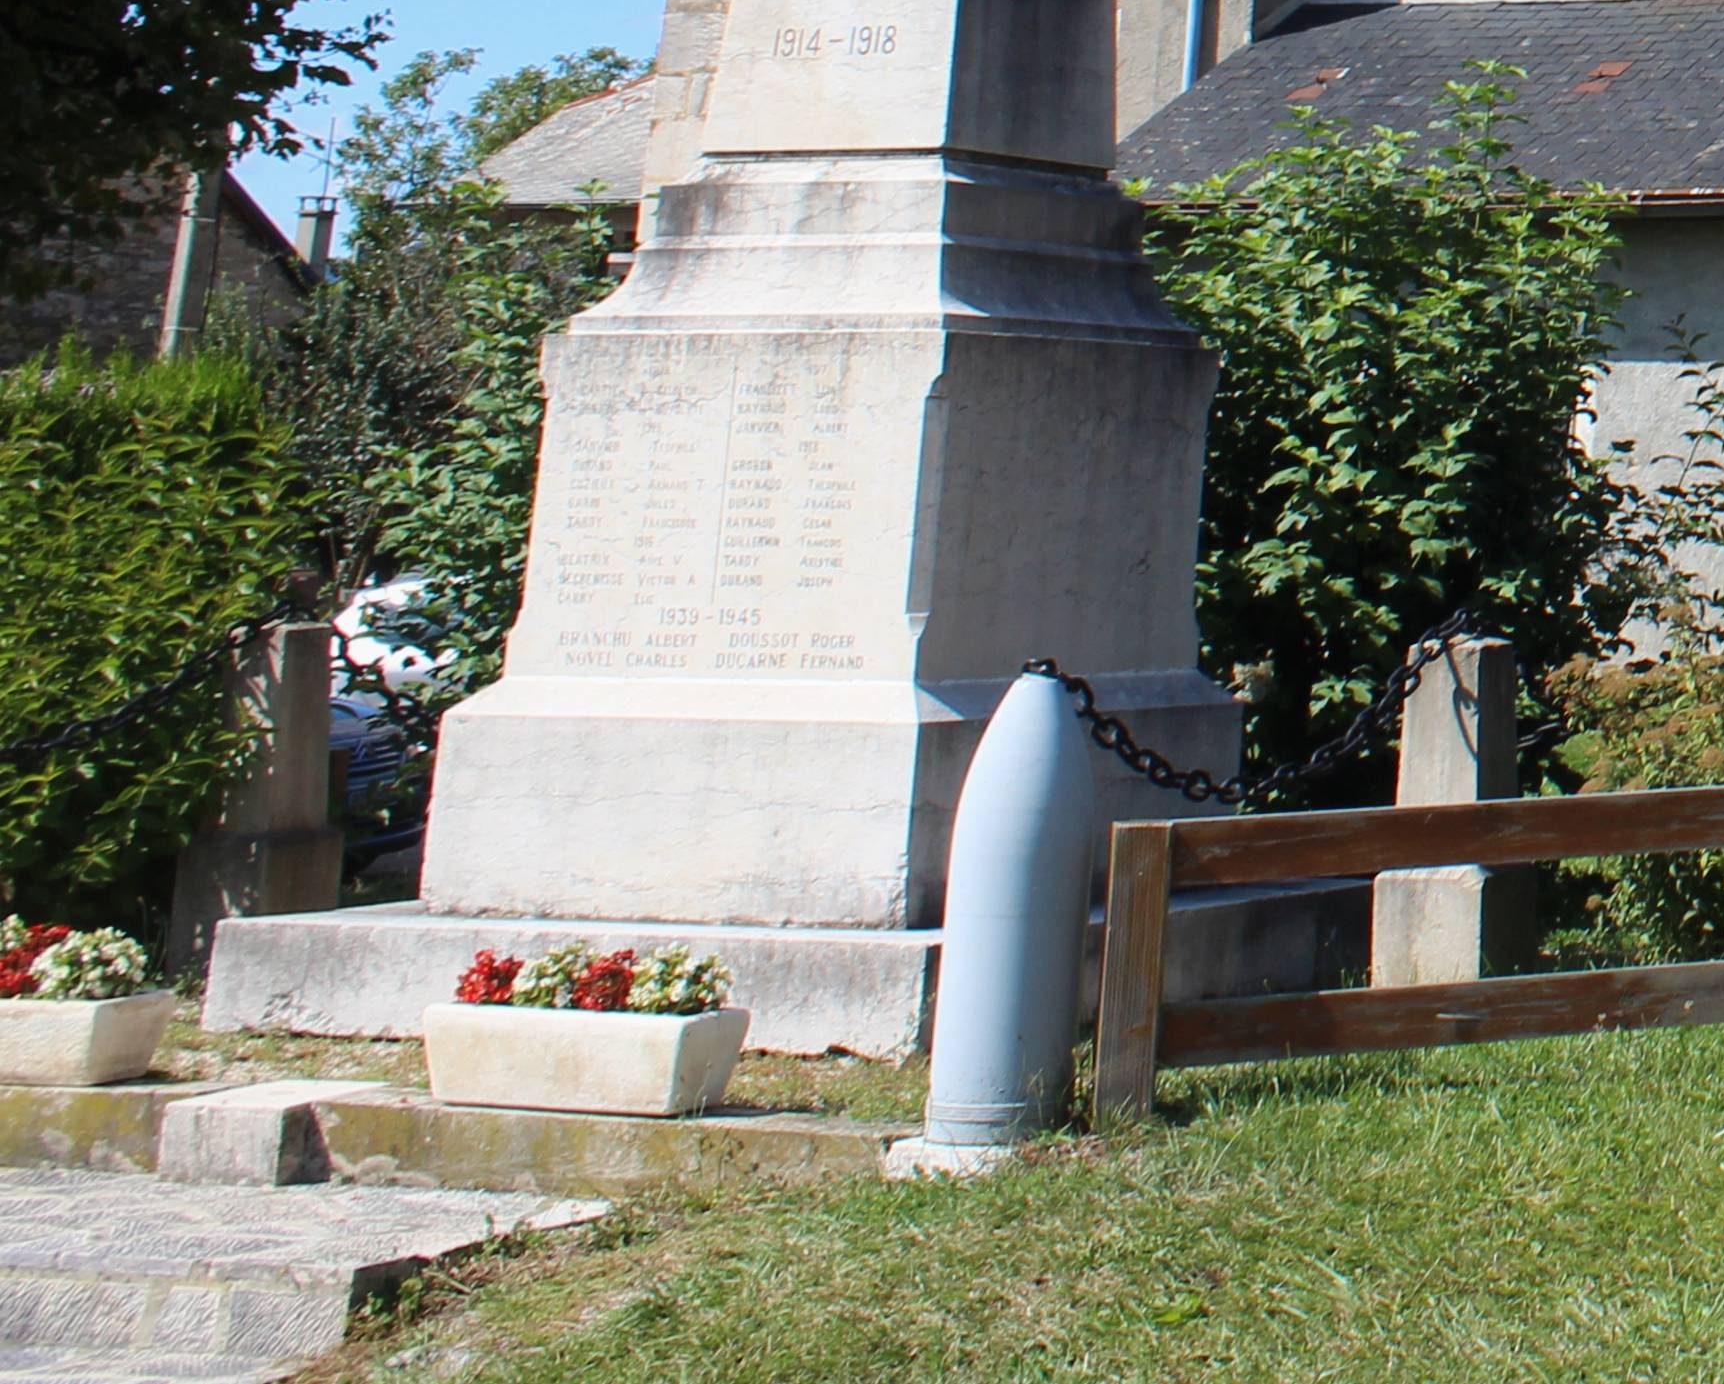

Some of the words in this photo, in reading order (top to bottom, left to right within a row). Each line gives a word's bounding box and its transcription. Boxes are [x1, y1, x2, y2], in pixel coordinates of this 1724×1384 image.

[720, 574, 763, 587] DURAND
[559, 630, 632, 648] BRANCHU
[645, 633, 698, 648] ALBERT
[728, 632, 800, 649] DOUSSOT
[810, 633, 855, 649] ROGER
[565, 651, 615, 667] NOVEL
[625, 652, 688, 668] CHARLES
[800, 653, 864, 670] FERNAND
